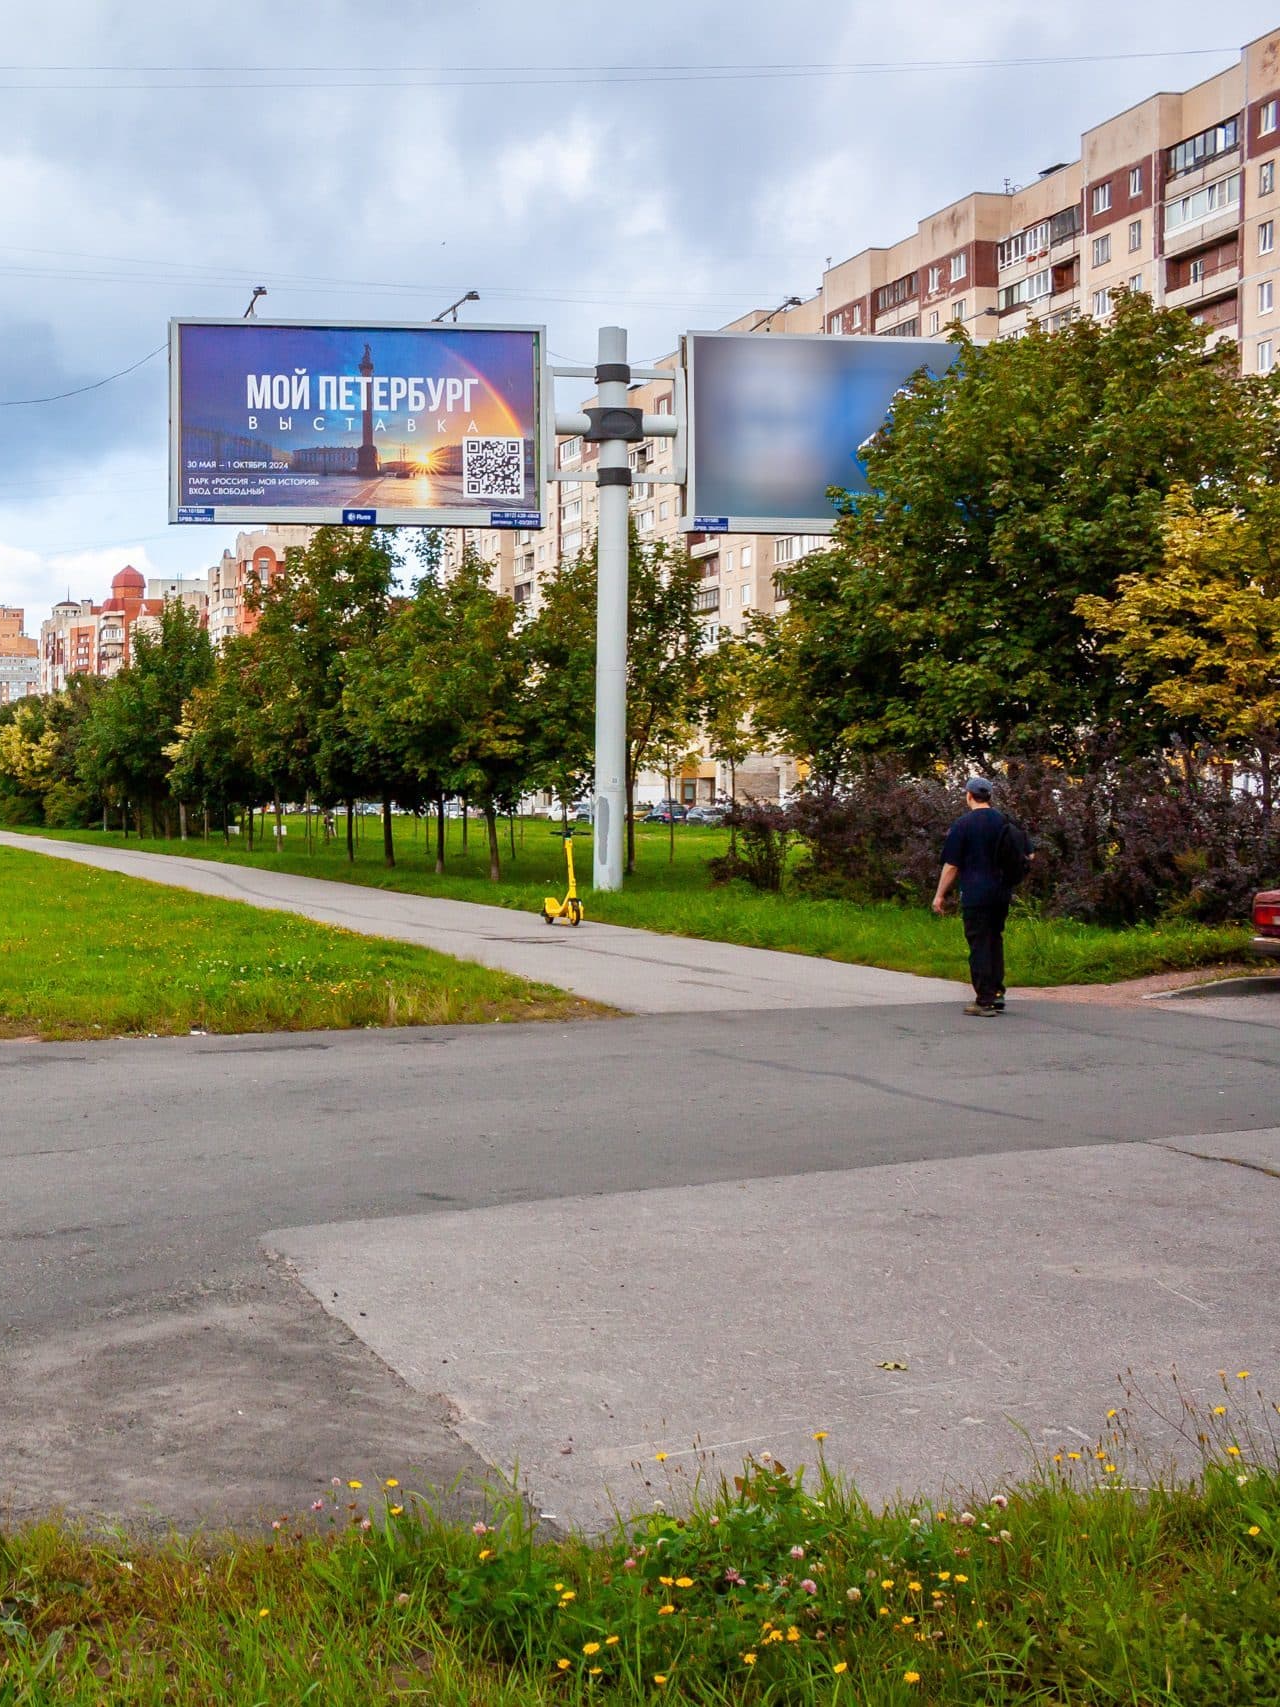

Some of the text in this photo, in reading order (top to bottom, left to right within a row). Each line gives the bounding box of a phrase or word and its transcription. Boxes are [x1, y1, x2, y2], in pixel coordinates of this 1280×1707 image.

[246, 368, 479, 412] МОЙ ПЕТЕРБУРГ
[248, 416, 479, 433] ВЫСТАВКА
[186, 460, 197, 468] 30
[199, 460, 217, 468] МАЯ
[232, 461, 267, 469] ОКТЯБРЯ
[268, 461, 289, 470] 2024
[188, 477, 209, 486] ПАРК
[211, 477, 249, 486] «РОССИЯ
[258, 478, 277, 486] МОЯ
[277, 478, 320, 487] ИСТОРИЯ»
[188, 486, 265, 496] ВХОД СВОБОДНЫЙ
